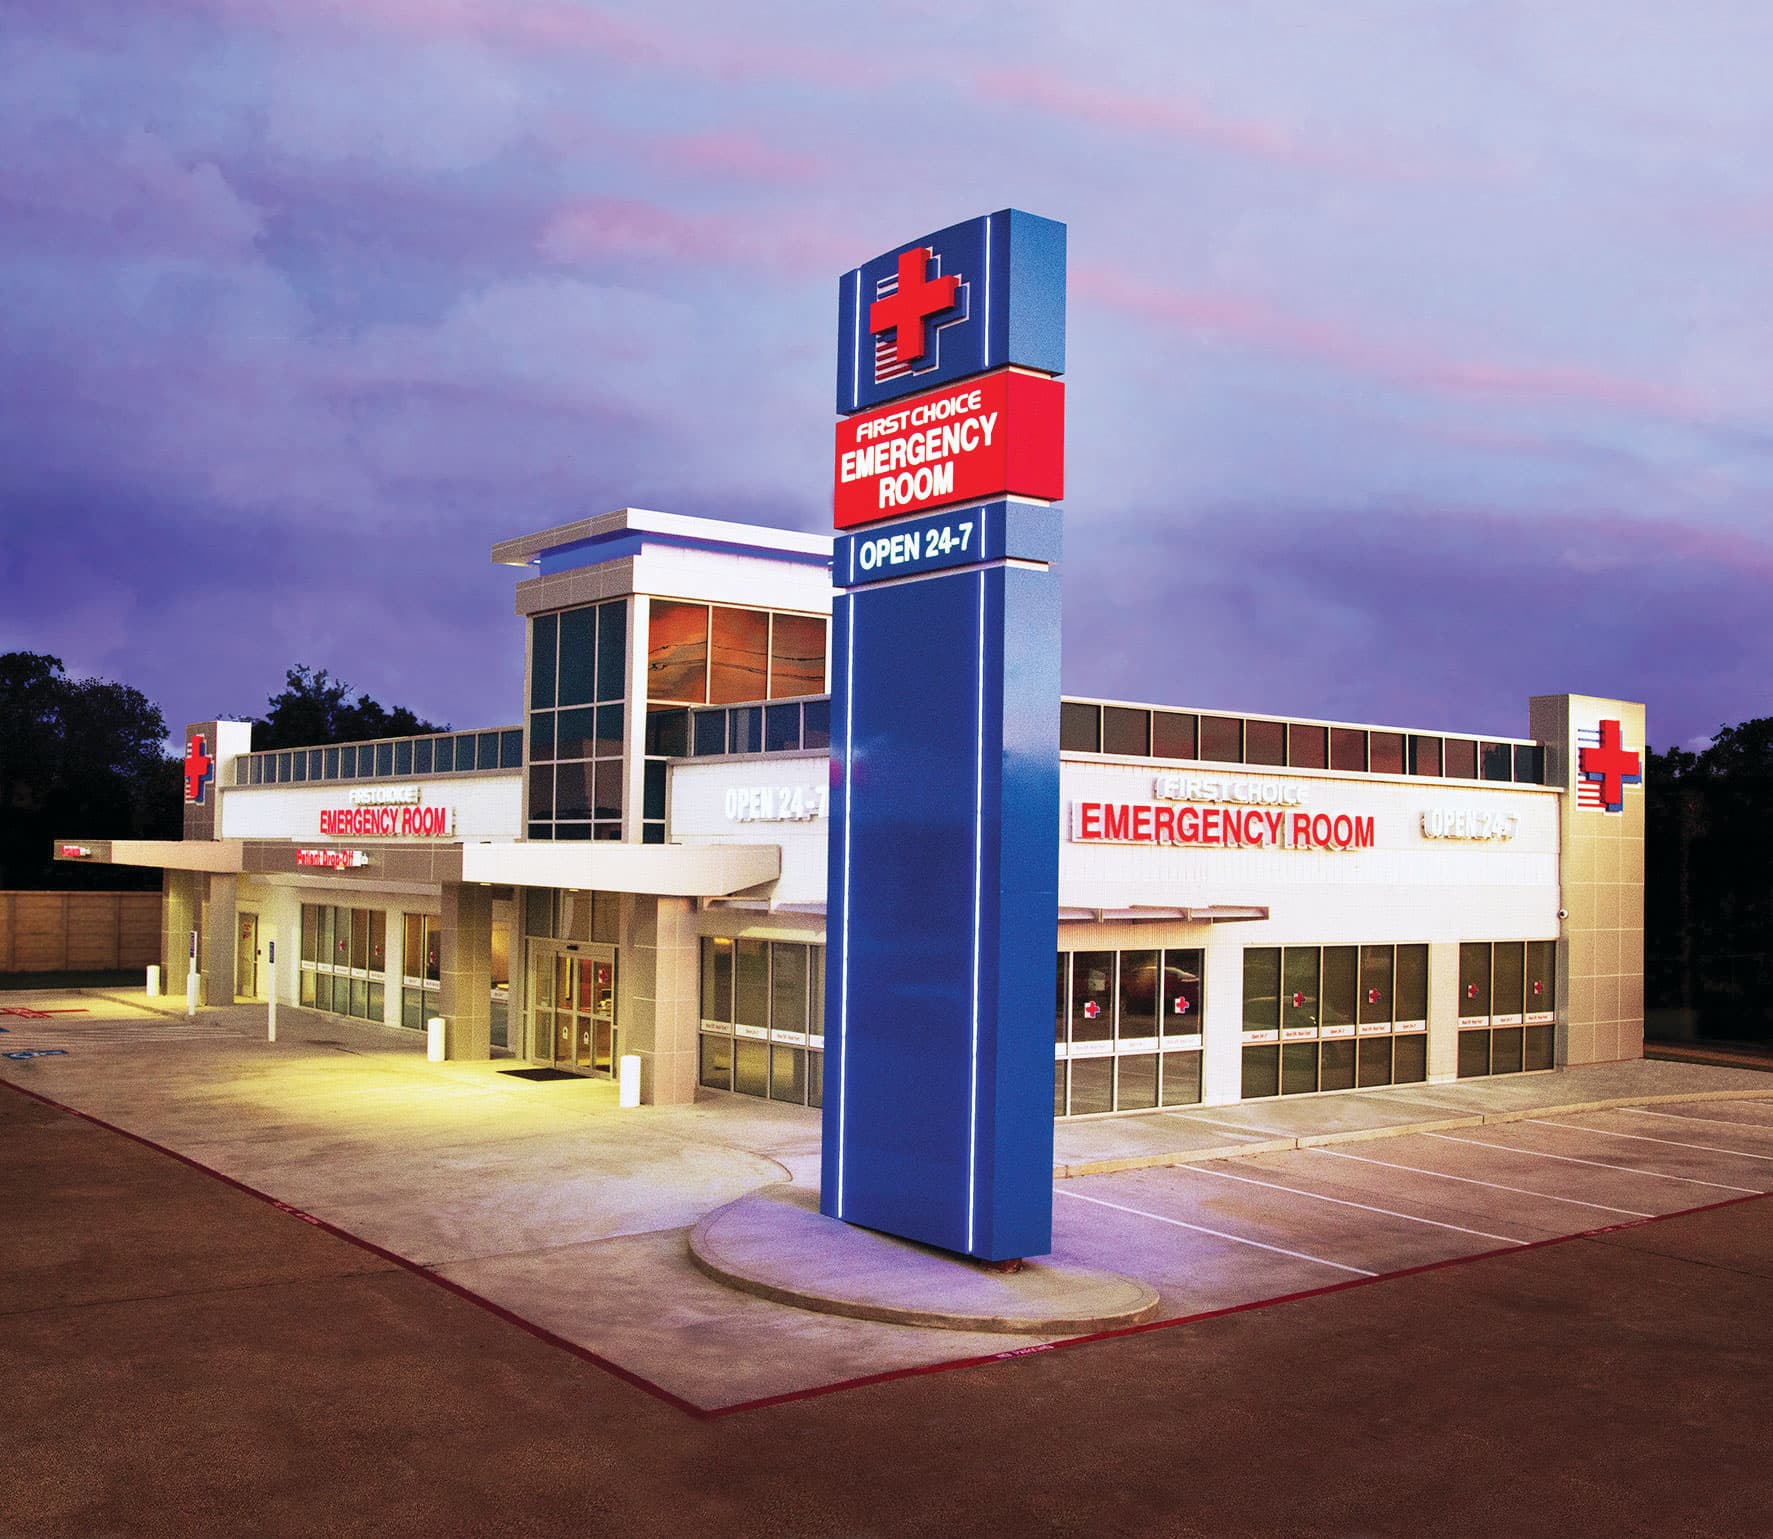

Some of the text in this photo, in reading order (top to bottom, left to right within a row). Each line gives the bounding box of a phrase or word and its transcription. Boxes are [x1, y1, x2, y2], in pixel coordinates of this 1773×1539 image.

[856, 389, 982, 442] FIRST CHOICE
[841, 411, 998, 483] EMERGENCY
[878, 461, 954, 509] ROOM
[859, 522, 973, 570] OPEN 24-7
[725, 786, 774, 819] OPEN
[1160, 775, 1309, 806] FIRST CHOICE
[320, 806, 446, 835] EMERGENCY ROOM
[1081, 802, 1375, 848] EMERGENCY ROOM
[1427, 807, 1474, 838] OPEN
